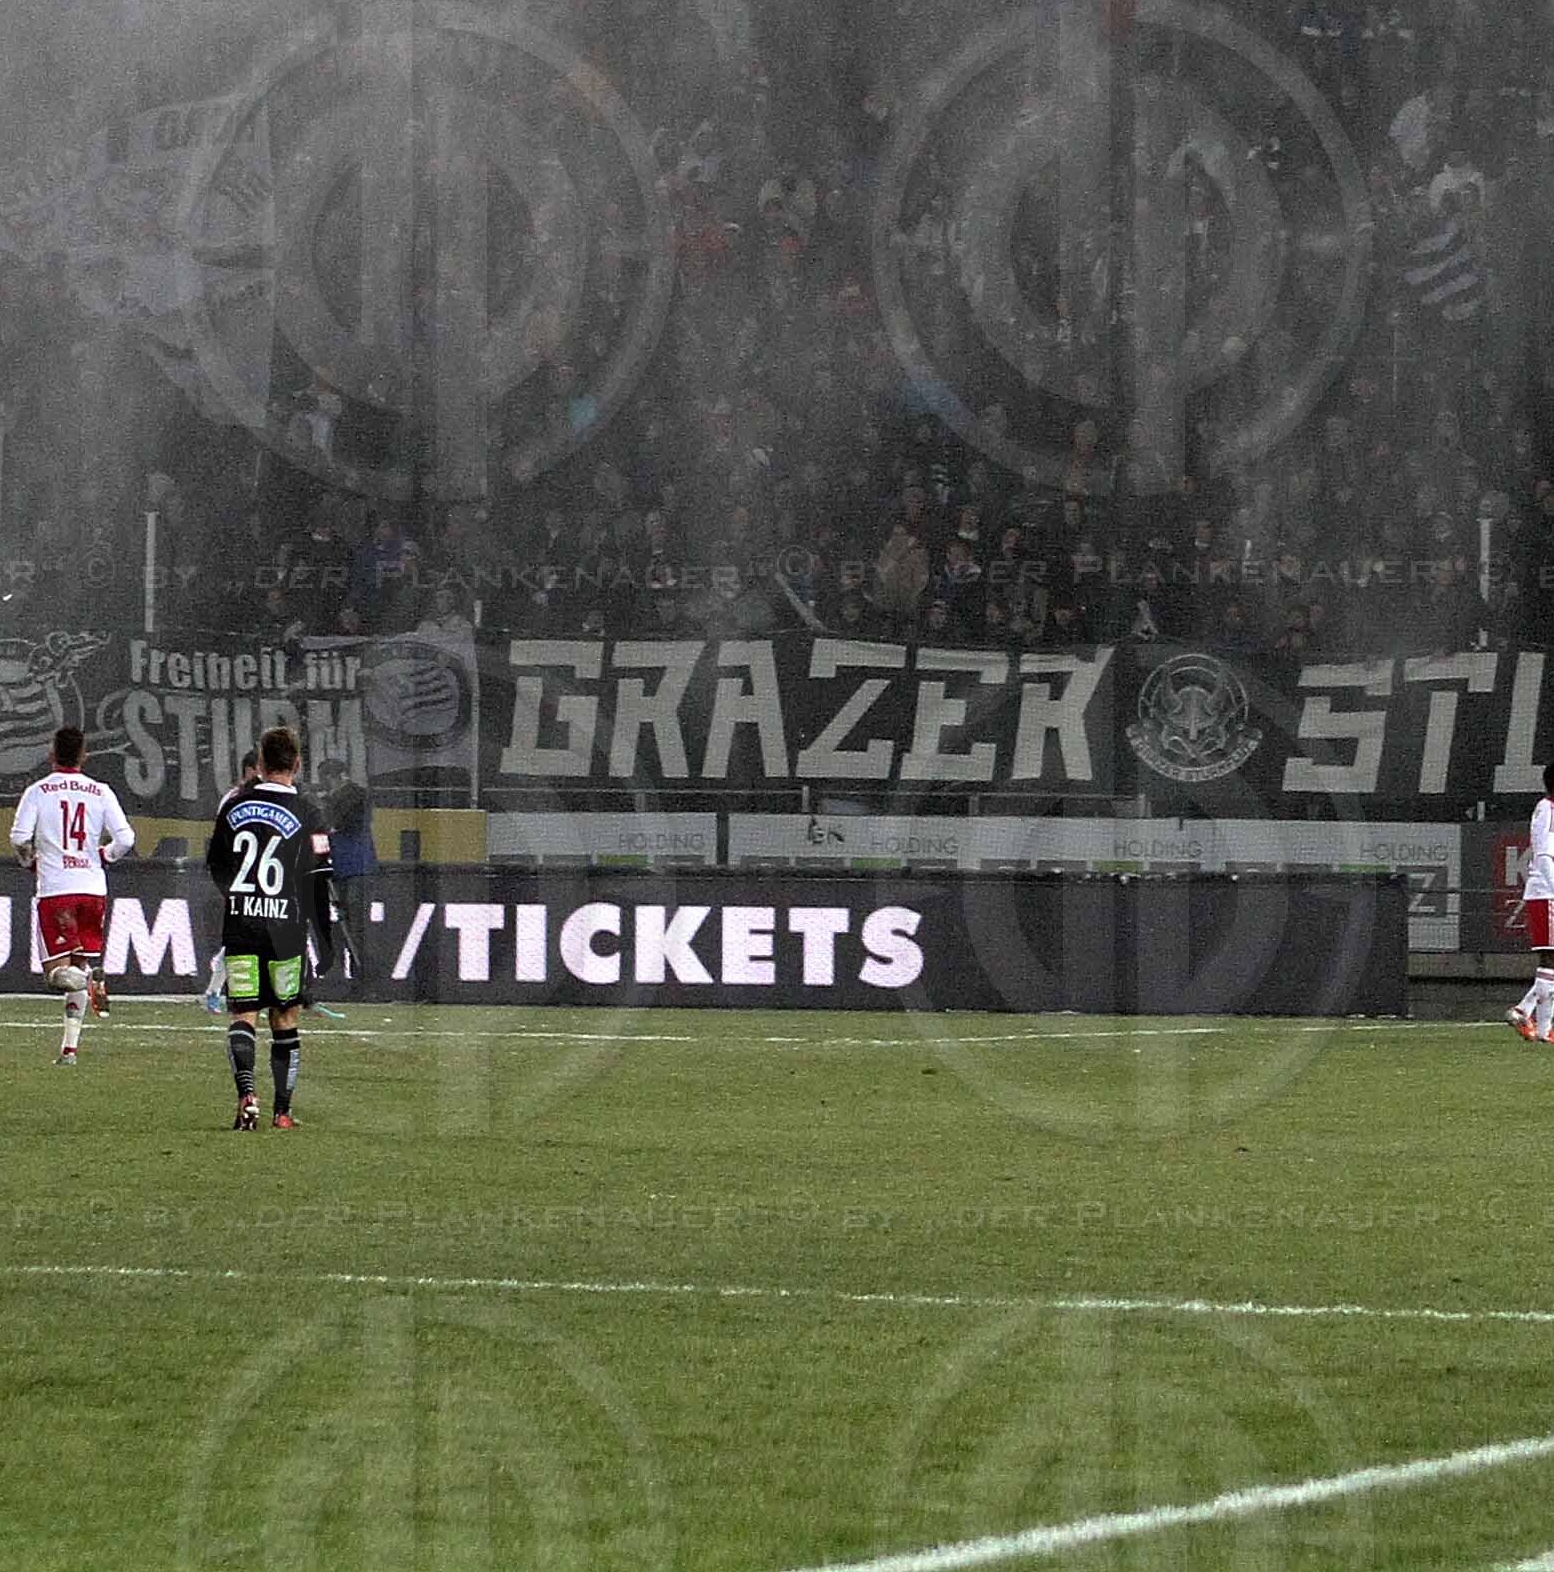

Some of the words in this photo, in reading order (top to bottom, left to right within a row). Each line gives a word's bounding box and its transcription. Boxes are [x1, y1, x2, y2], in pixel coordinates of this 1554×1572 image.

[129, 638, 288, 691] Freiheit
[304, 649, 362, 691] für
[498, 638, 1115, 781] GRAZER
[60, 799, 87, 852] 14
[230, 805, 296, 832] PUNTIGAMER
[619, 833, 705, 851] HOLDING
[871, 835, 959, 854] HOLDING
[1114, 839, 1203, 859] HOLDING
[1359, 842, 1448, 861] HOLDING
[229, 830, 285, 896] 26
[243, 895, 289, 919] KAINZ
